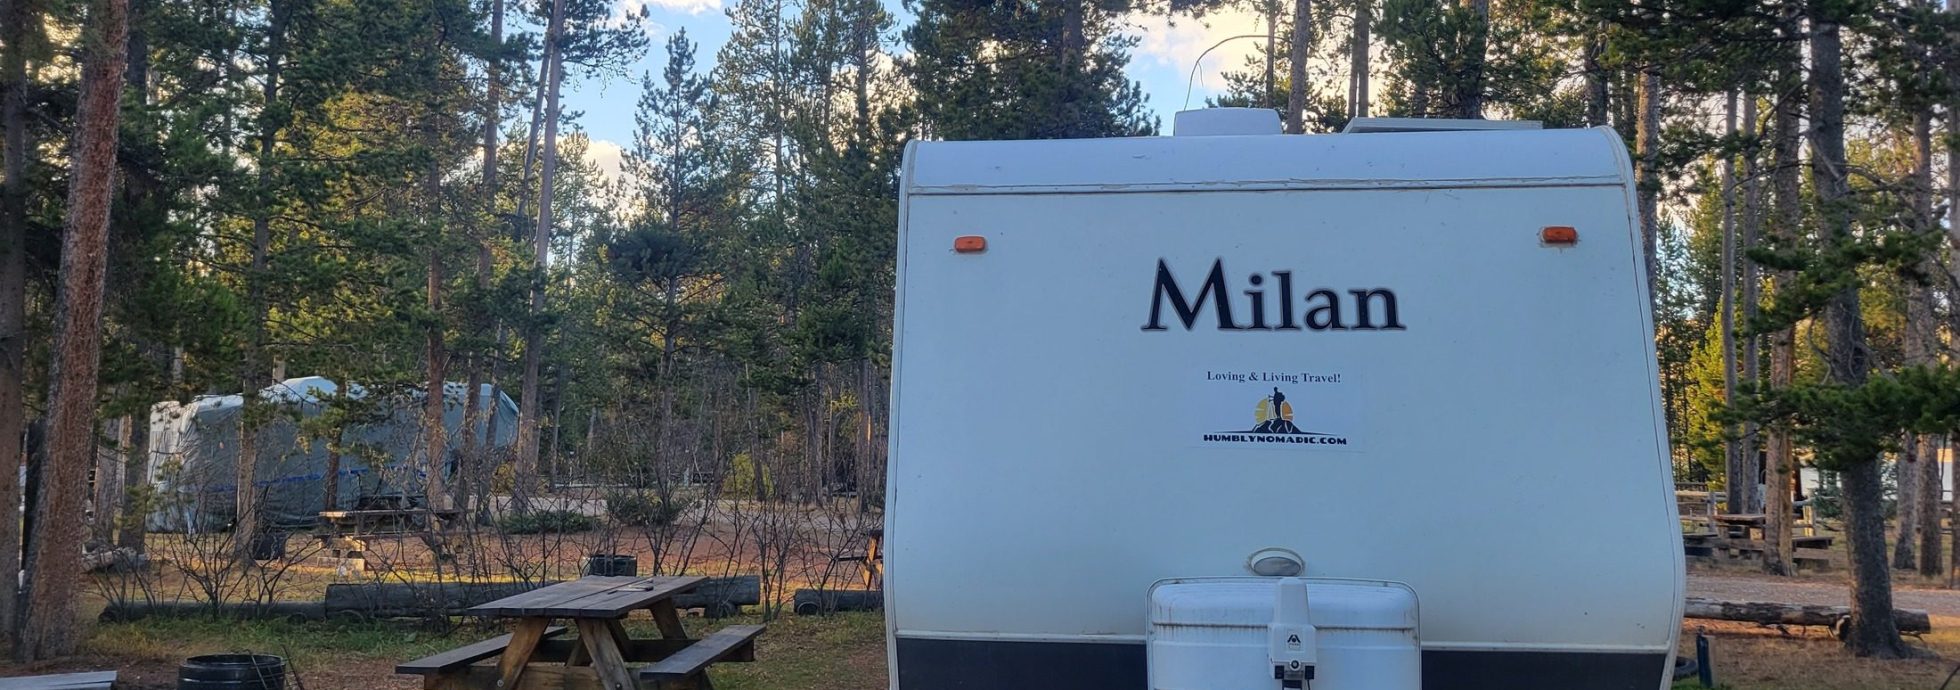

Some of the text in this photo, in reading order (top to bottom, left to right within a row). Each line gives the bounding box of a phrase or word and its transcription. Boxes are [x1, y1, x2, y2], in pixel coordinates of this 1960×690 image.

[1141, 256, 1407, 332] Milan
[1207, 371, 1341, 384] Loving & Living Travel!
[1203, 434, 1347, 445] HUMBLYNOMADIC.COM
